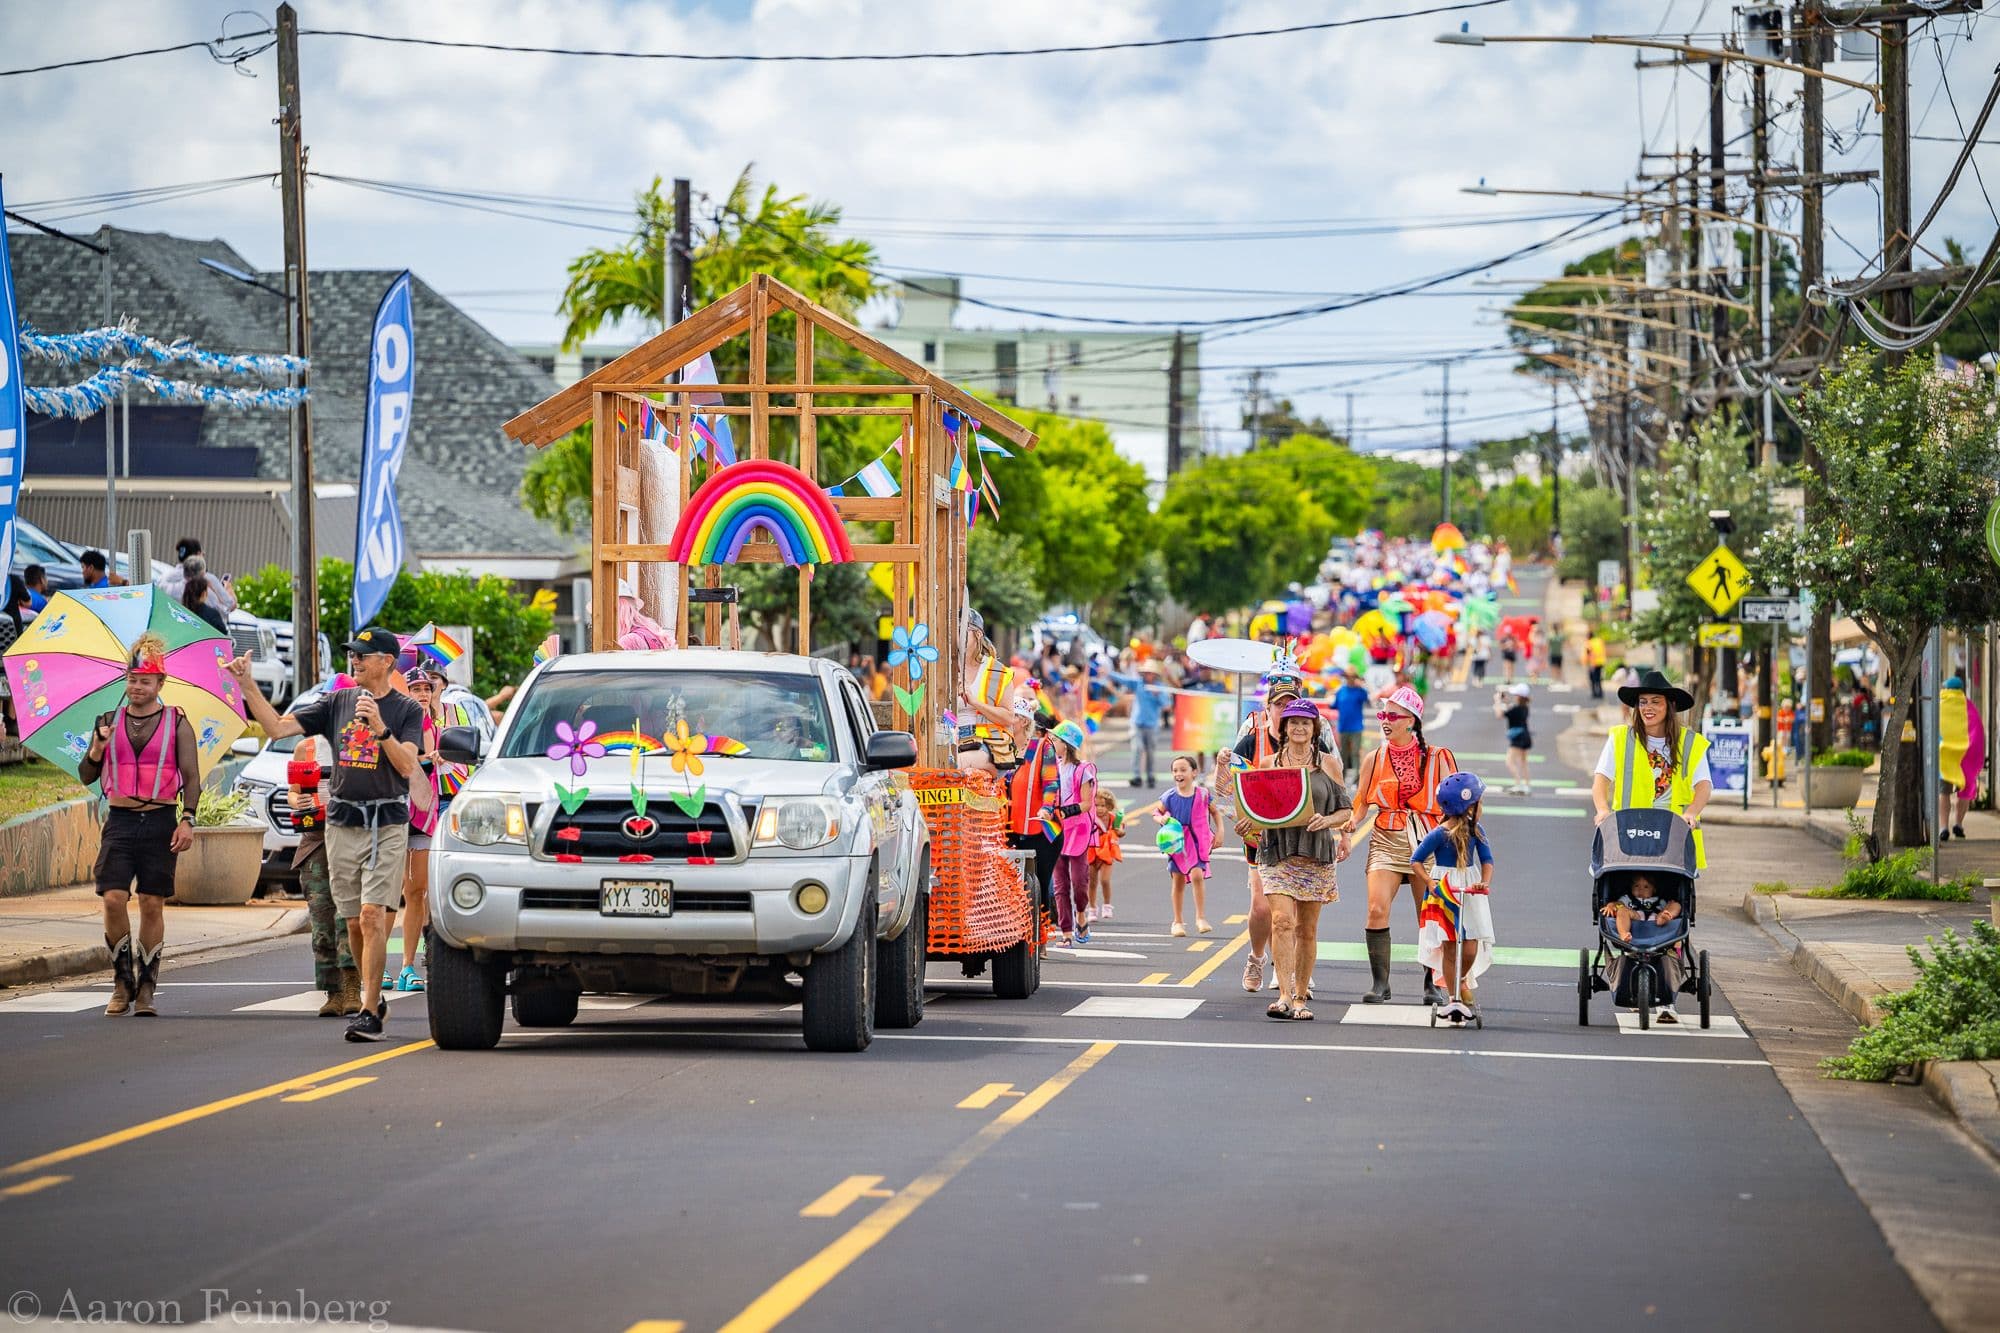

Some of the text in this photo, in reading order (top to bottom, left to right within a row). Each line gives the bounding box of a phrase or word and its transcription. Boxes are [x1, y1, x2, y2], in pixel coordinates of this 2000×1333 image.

[360, 323, 409, 583] OPN
[603, 887, 669, 907] KYX 308
